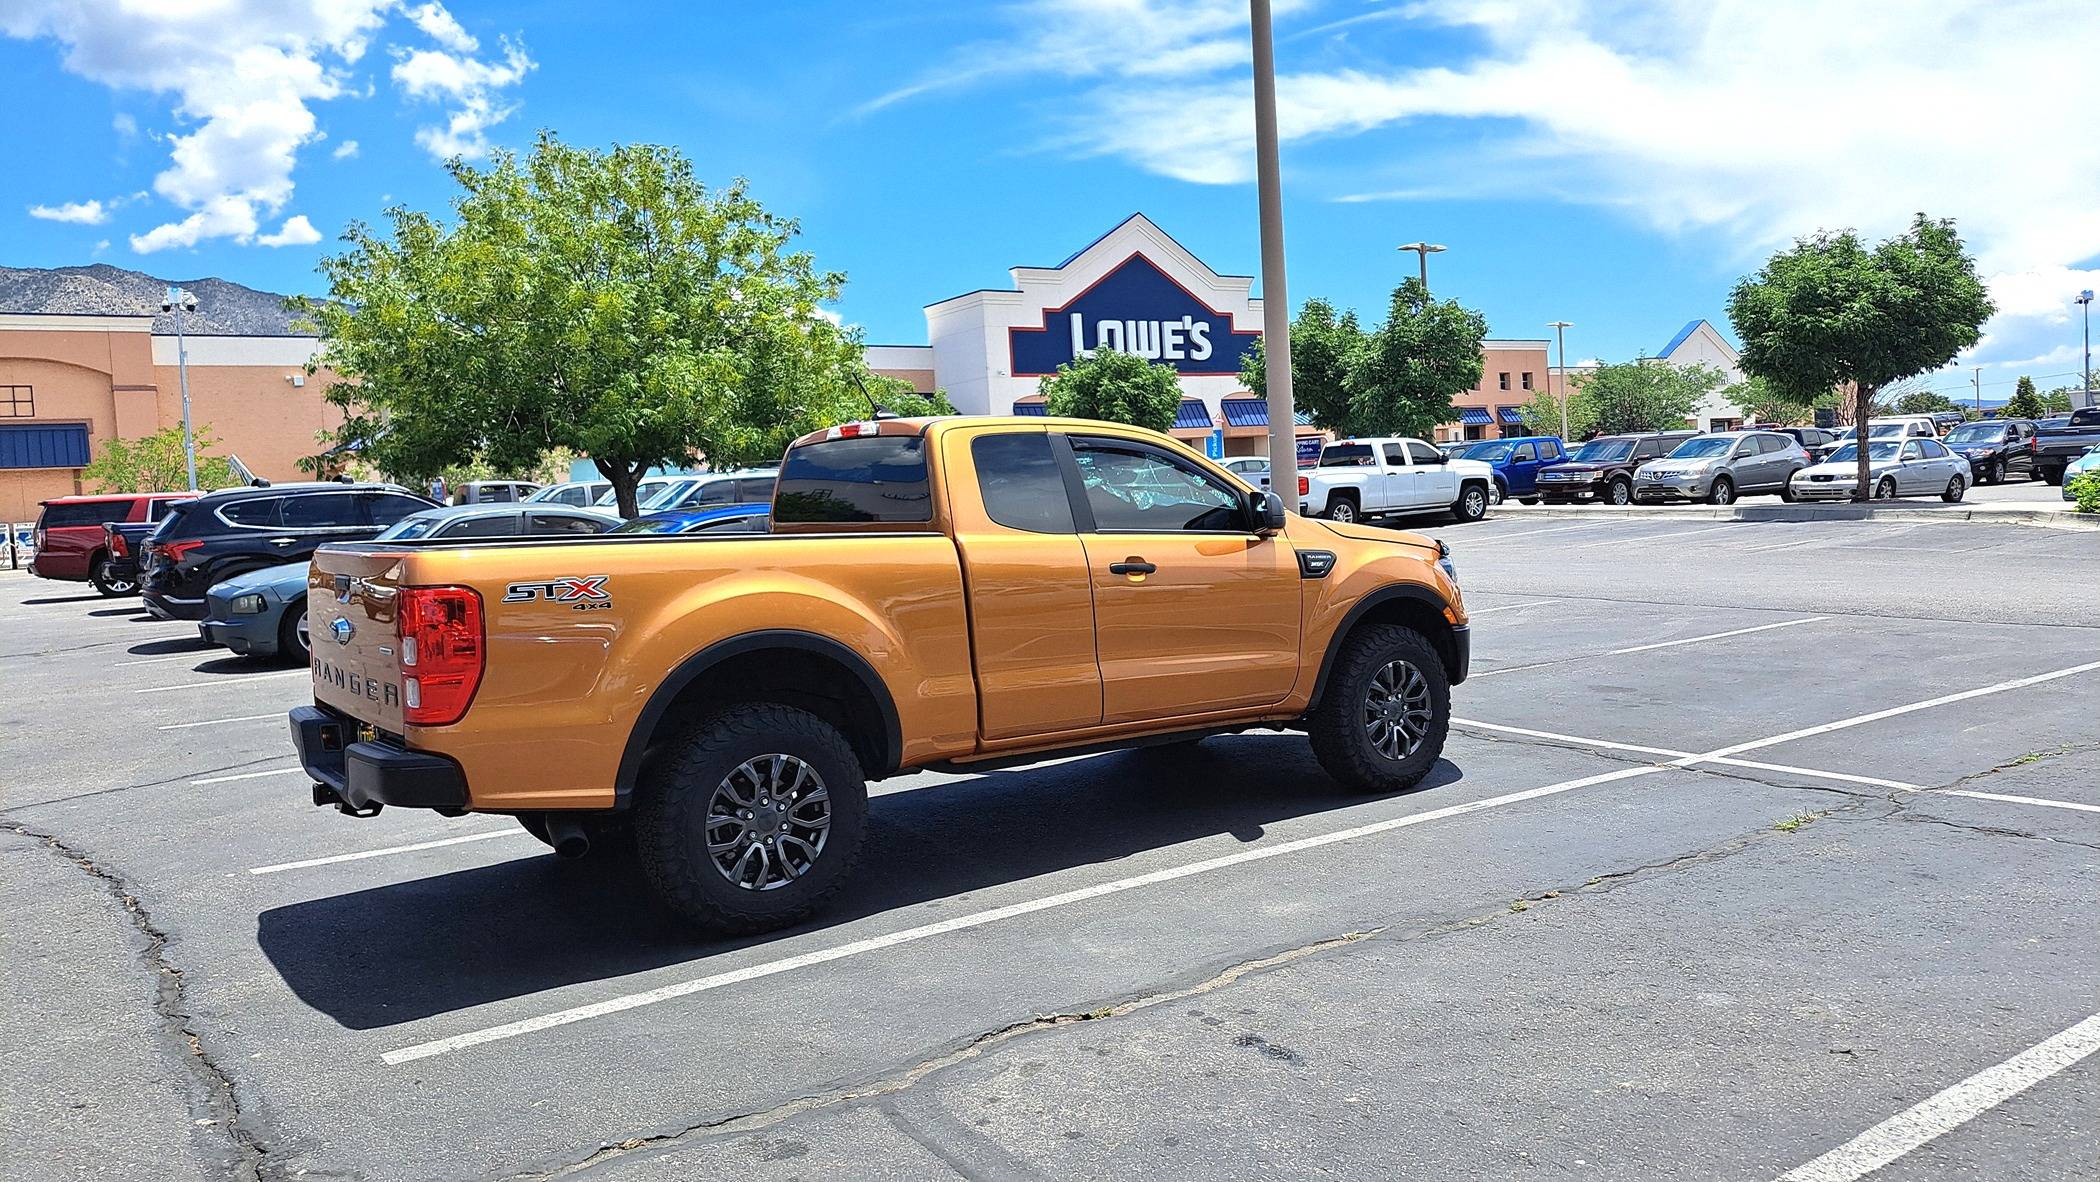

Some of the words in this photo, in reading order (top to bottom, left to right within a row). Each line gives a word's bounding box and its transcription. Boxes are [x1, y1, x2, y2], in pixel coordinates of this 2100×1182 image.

[1070, 312, 1213, 361] LOWE'S
[501, 574, 612, 604] STX
[313, 656, 400, 707] RANGER
